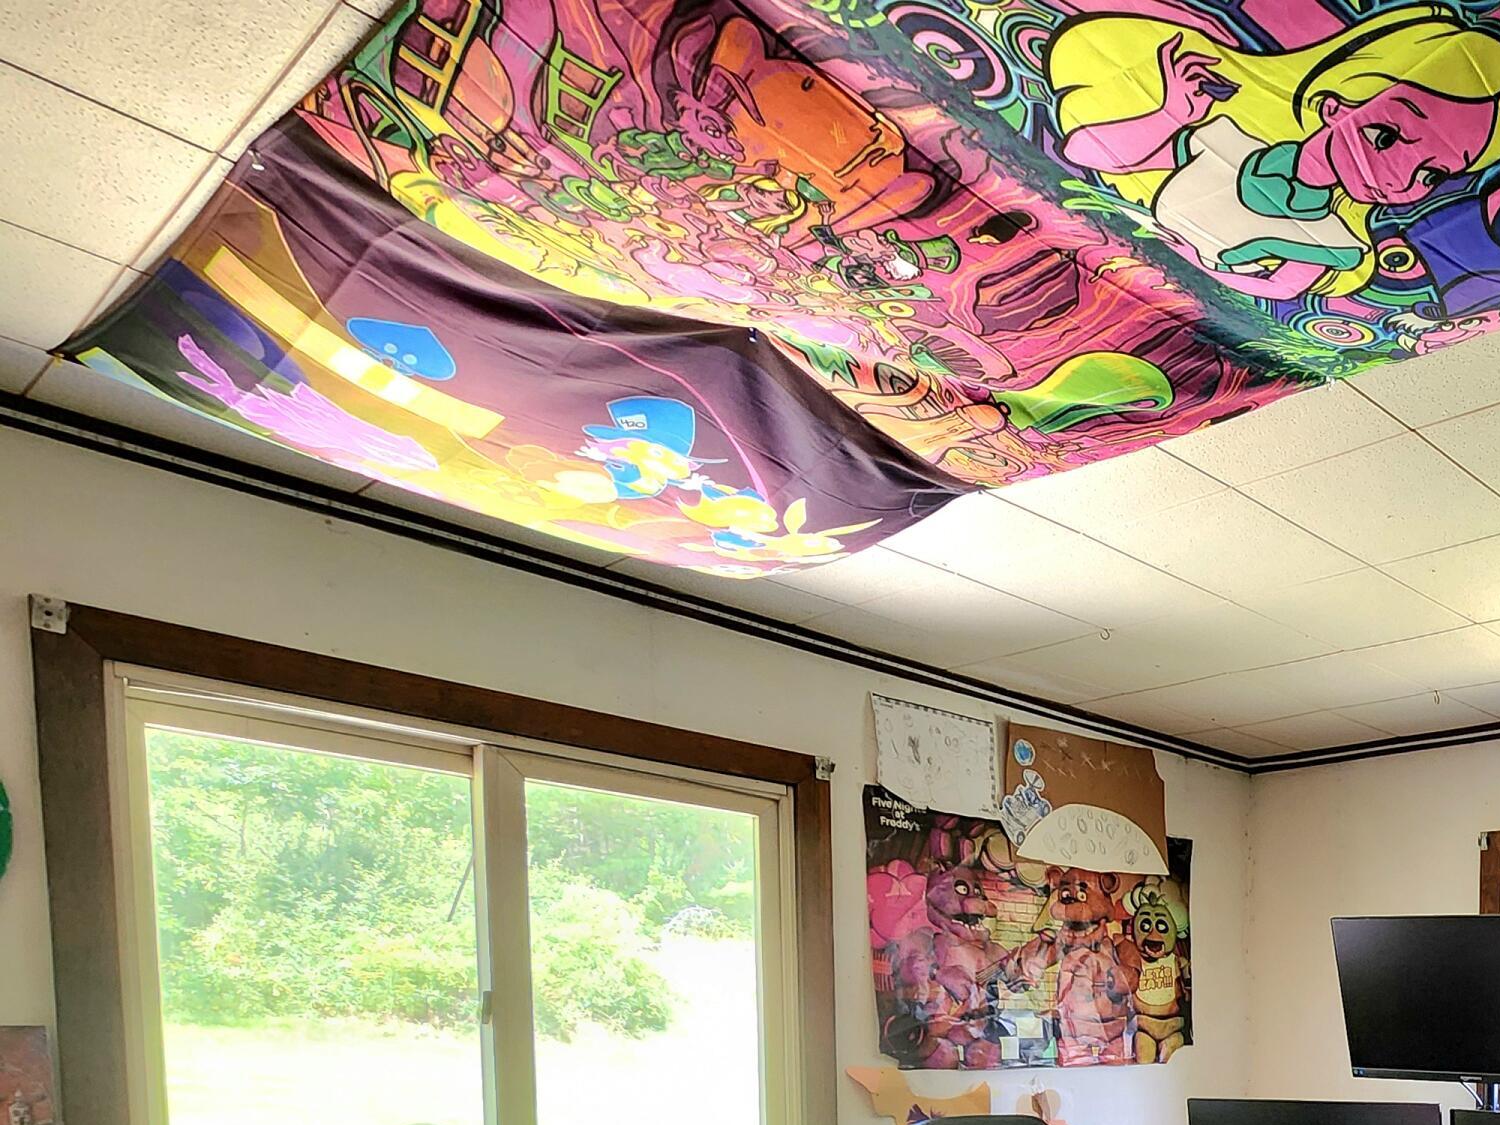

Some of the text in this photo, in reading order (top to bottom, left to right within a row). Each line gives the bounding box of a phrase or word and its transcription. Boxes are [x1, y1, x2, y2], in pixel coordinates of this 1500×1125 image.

[872, 797, 927, 813] Five Nig
[894, 810, 905, 819] at
